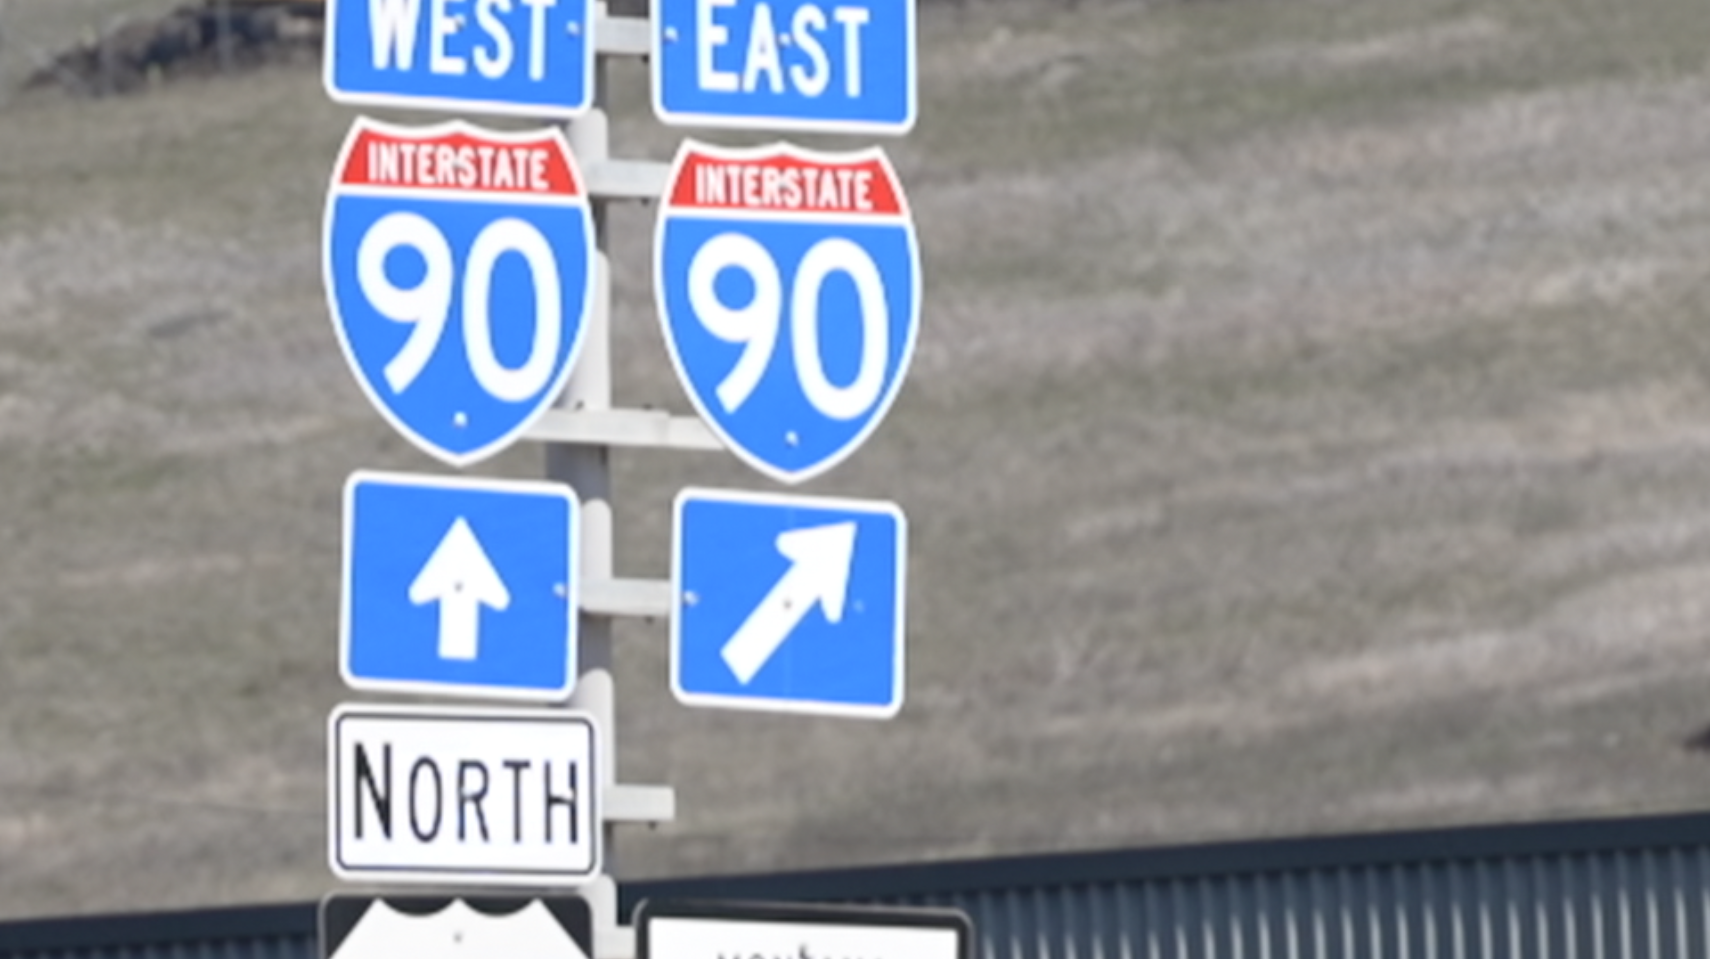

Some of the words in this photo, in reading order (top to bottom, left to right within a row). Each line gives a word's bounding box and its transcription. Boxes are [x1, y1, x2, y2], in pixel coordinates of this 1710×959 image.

[367, 141, 550, 191] INTERSTATE
[695, 164, 873, 211] INTERSTATE
[356, 211, 562, 402] 90
[687, 232, 890, 421] 90
[354, 742, 579, 844] NORTH
